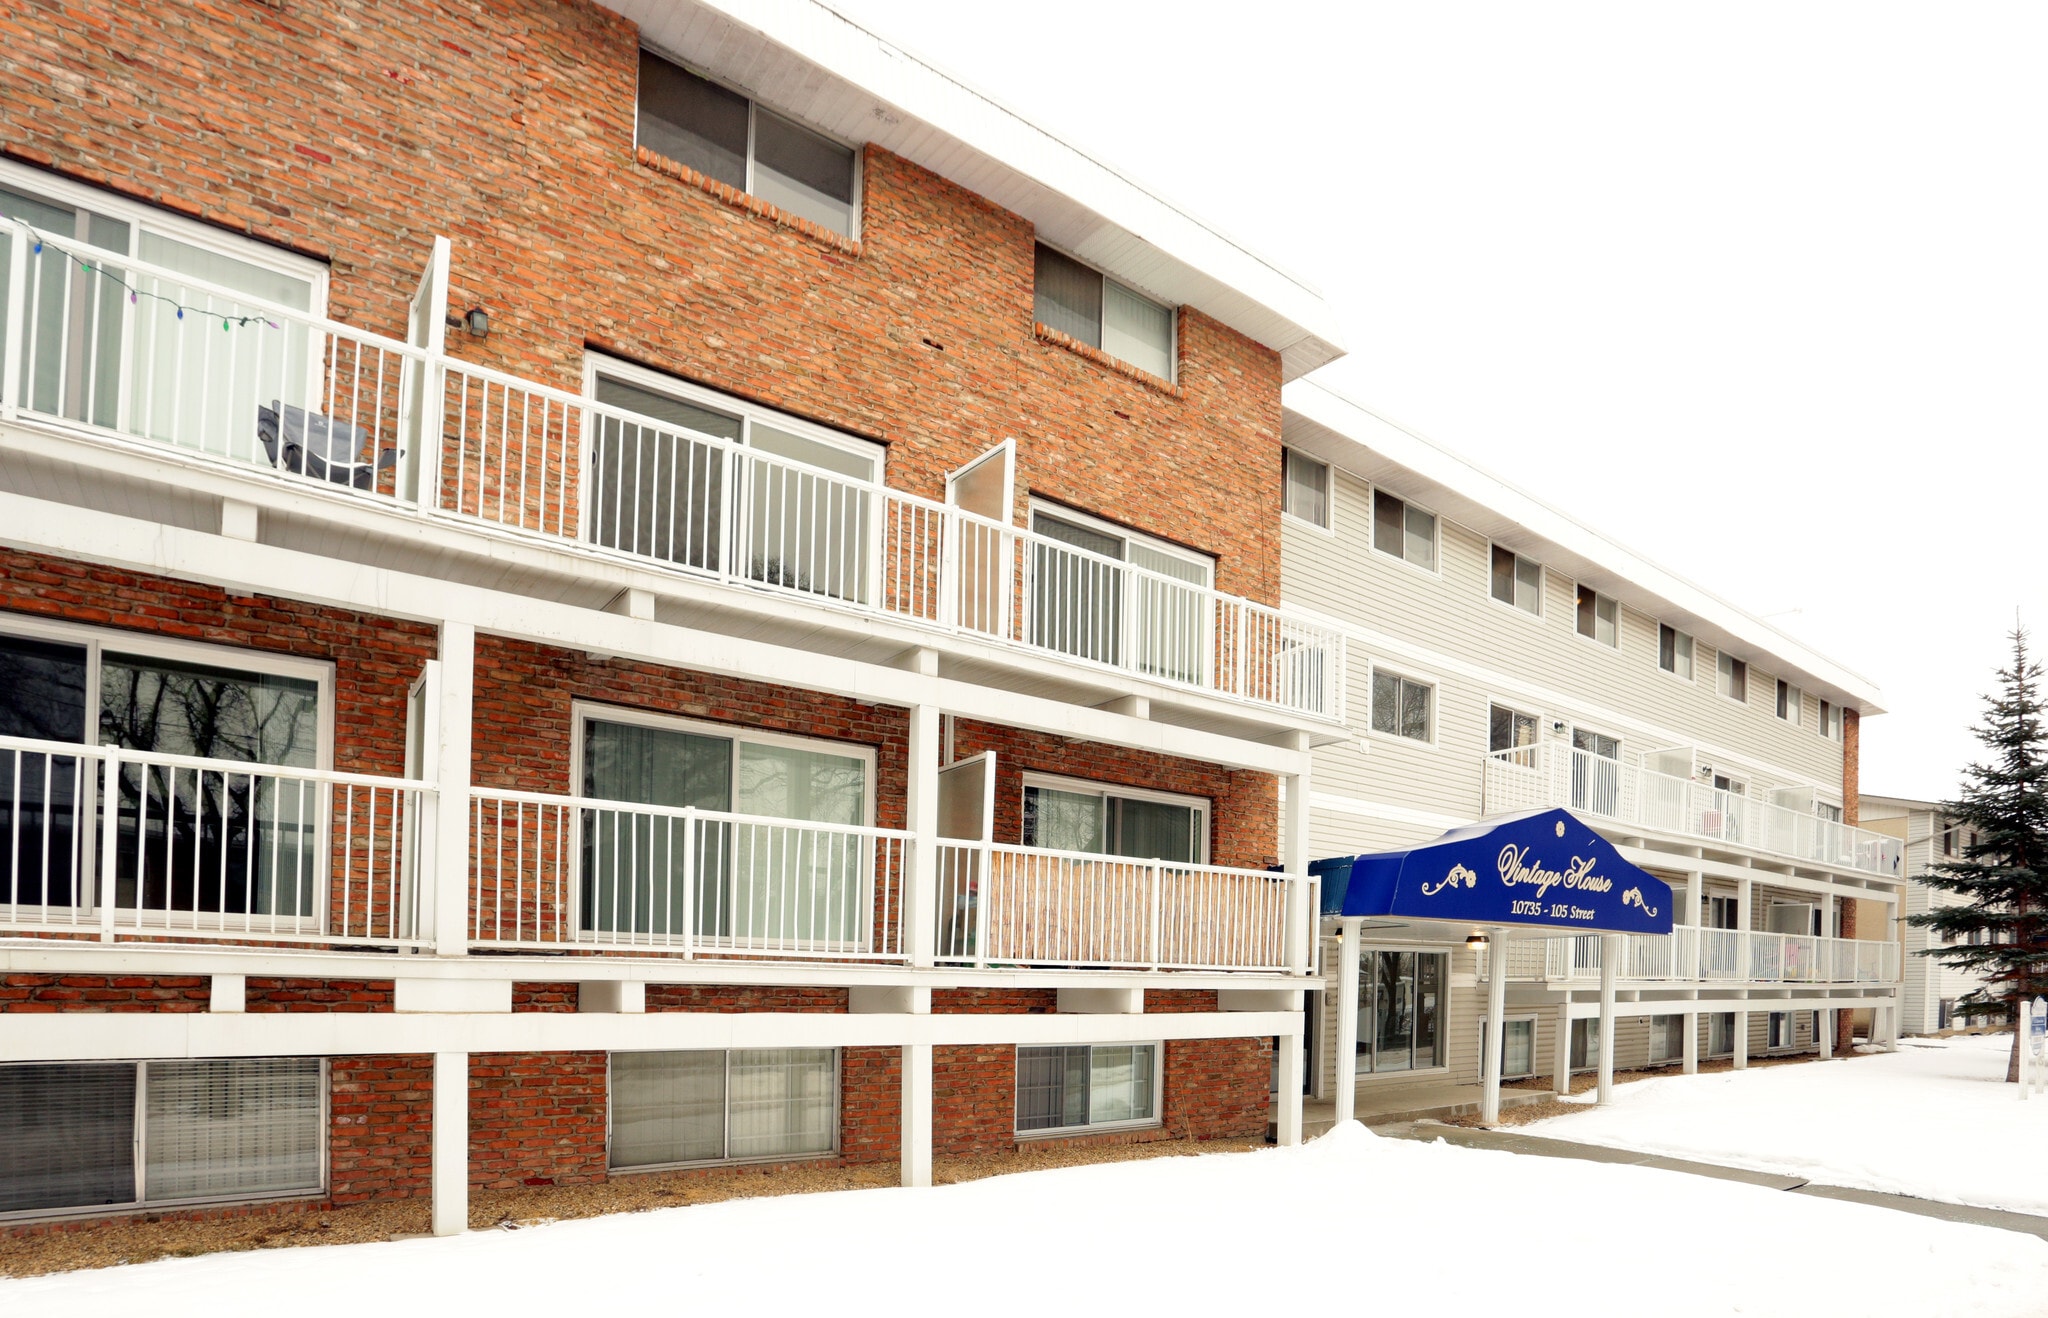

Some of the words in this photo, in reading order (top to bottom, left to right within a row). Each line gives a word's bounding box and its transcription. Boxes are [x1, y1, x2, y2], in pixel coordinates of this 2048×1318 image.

[1497, 843, 1562, 898] Vintage
[1563, 856, 1613, 893] House
[1511, 900, 1541, 916] 10735
[1551, 904, 1568, 918] 105
[1570, 906, 1595, 920] Street
